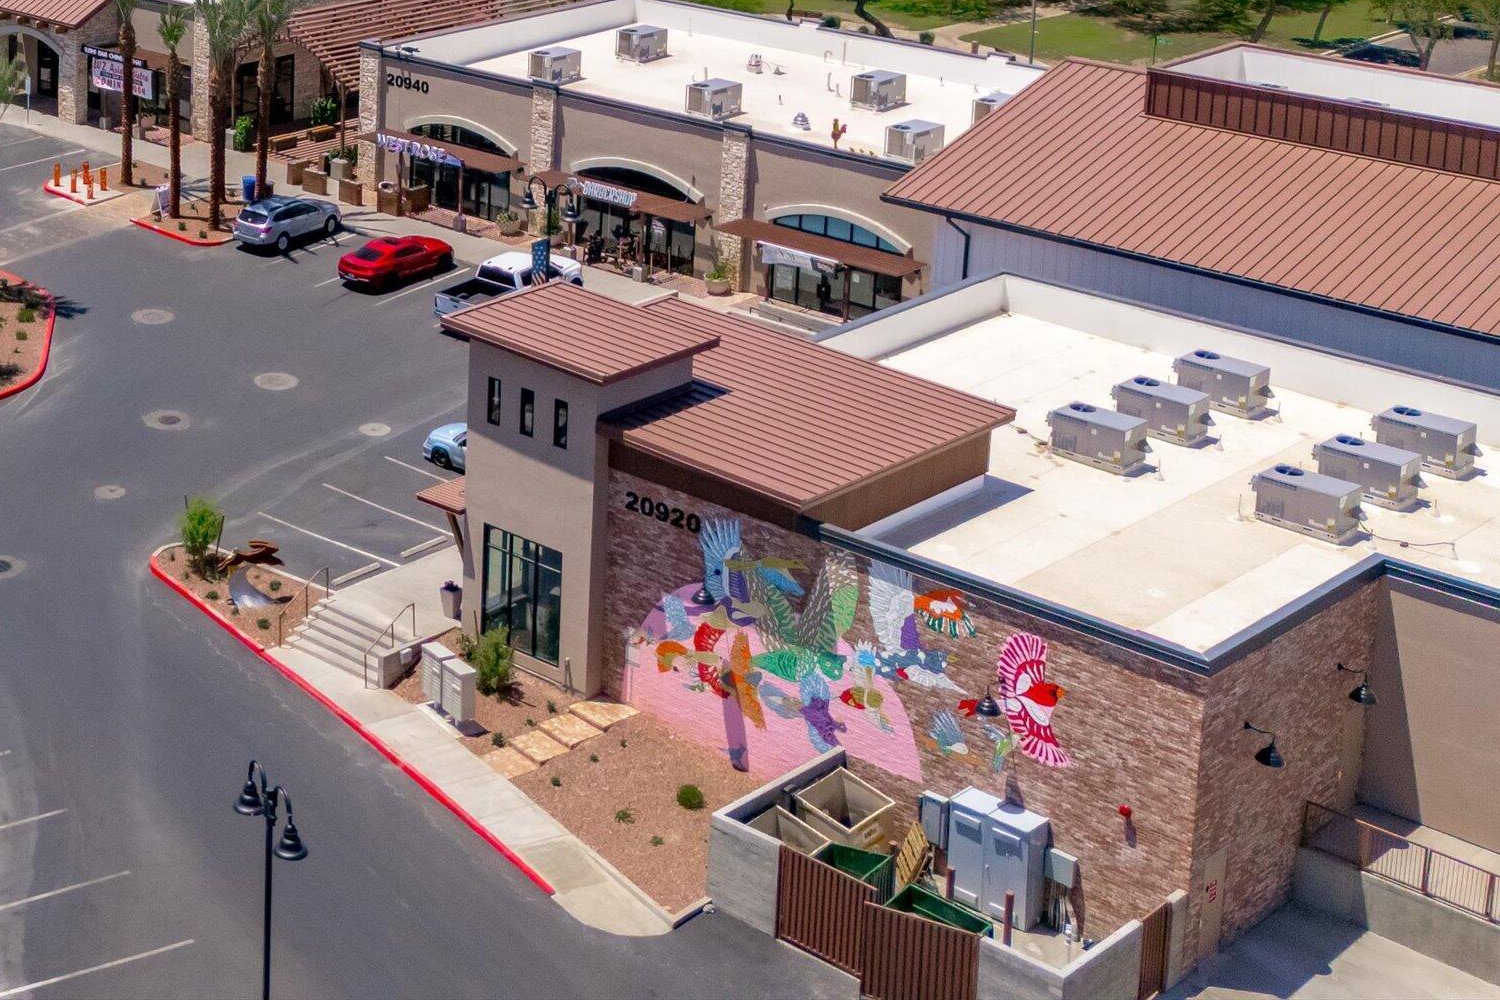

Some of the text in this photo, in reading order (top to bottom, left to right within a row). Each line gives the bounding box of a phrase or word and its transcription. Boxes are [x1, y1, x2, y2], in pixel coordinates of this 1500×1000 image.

[95, 76, 122, 89] COMIN
[386, 73, 430, 94] 20940
[583, 180, 637, 207] BARBERSHOP
[625, 491, 701, 534] 20920
